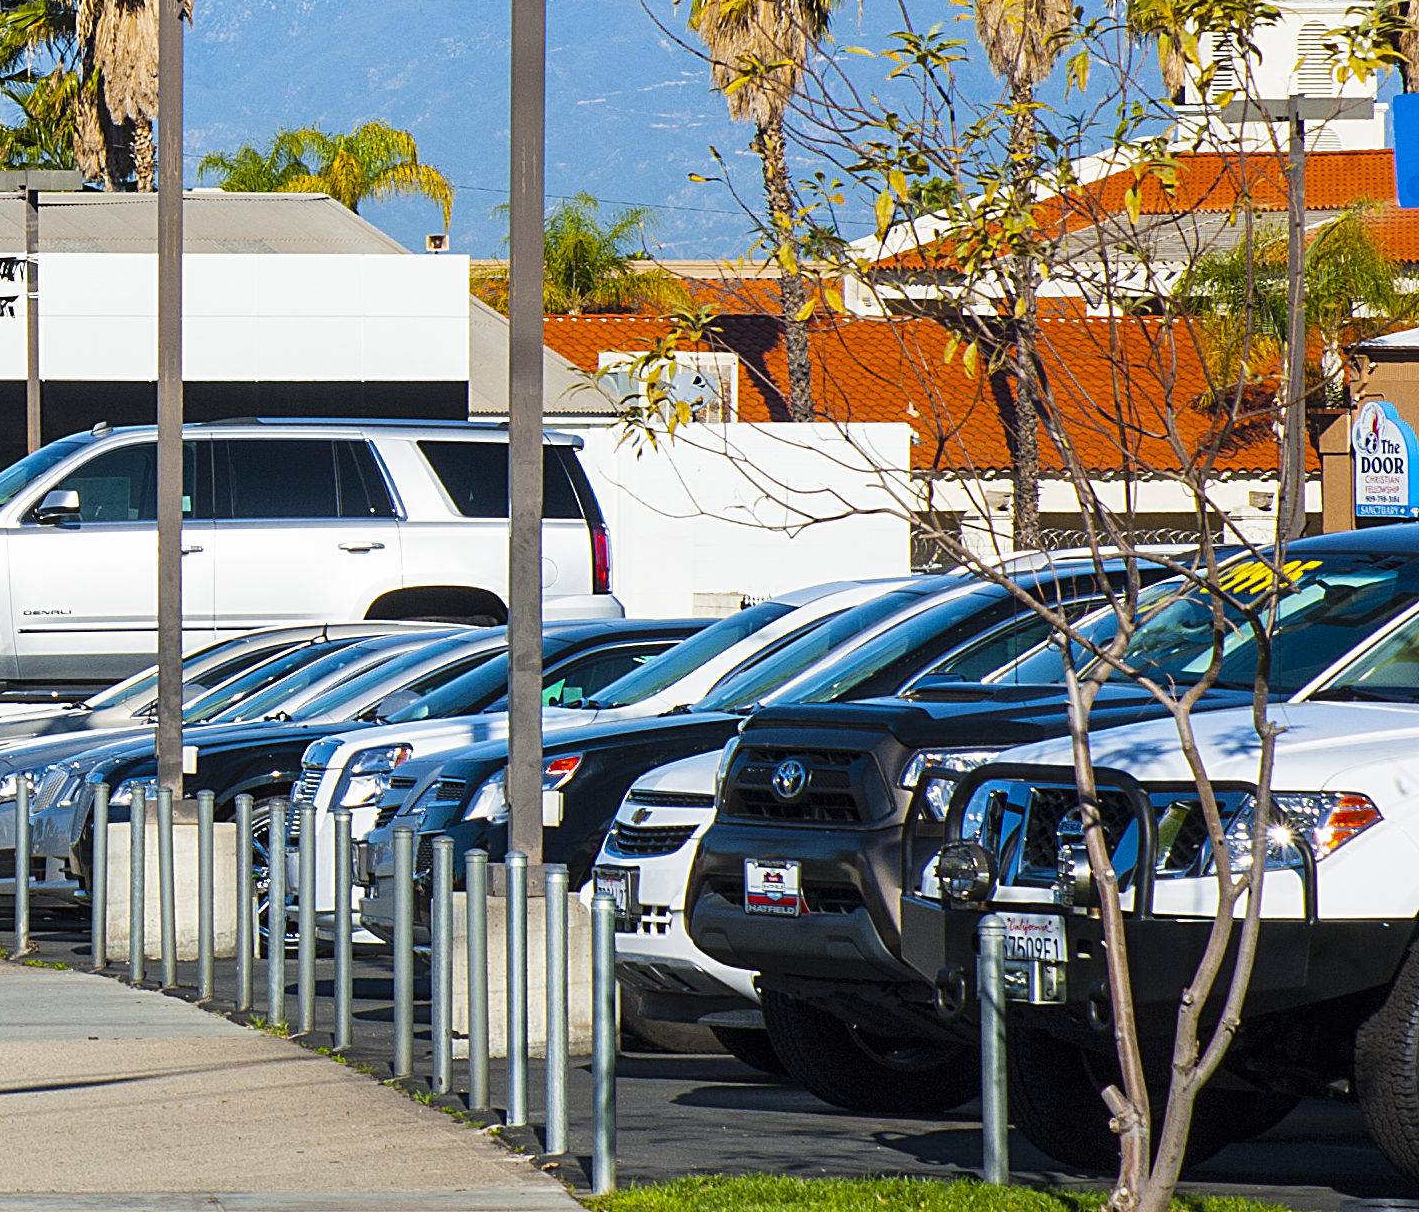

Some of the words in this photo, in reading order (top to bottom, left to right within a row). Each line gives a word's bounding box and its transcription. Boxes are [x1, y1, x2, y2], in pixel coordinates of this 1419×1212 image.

[1381, 439, 1400, 454] The
[1361, 457, 1404, 474] DOOR
[1365, 475, 1399, 484] CHRISTIAN
[1365, 485, 1399, 494] FELLOWSHIP
[1360, 506, 1398, 515] SANCTUARY
[748, 904, 795, 914] HATFIELD
[1009, 917, 1053, 935] California
